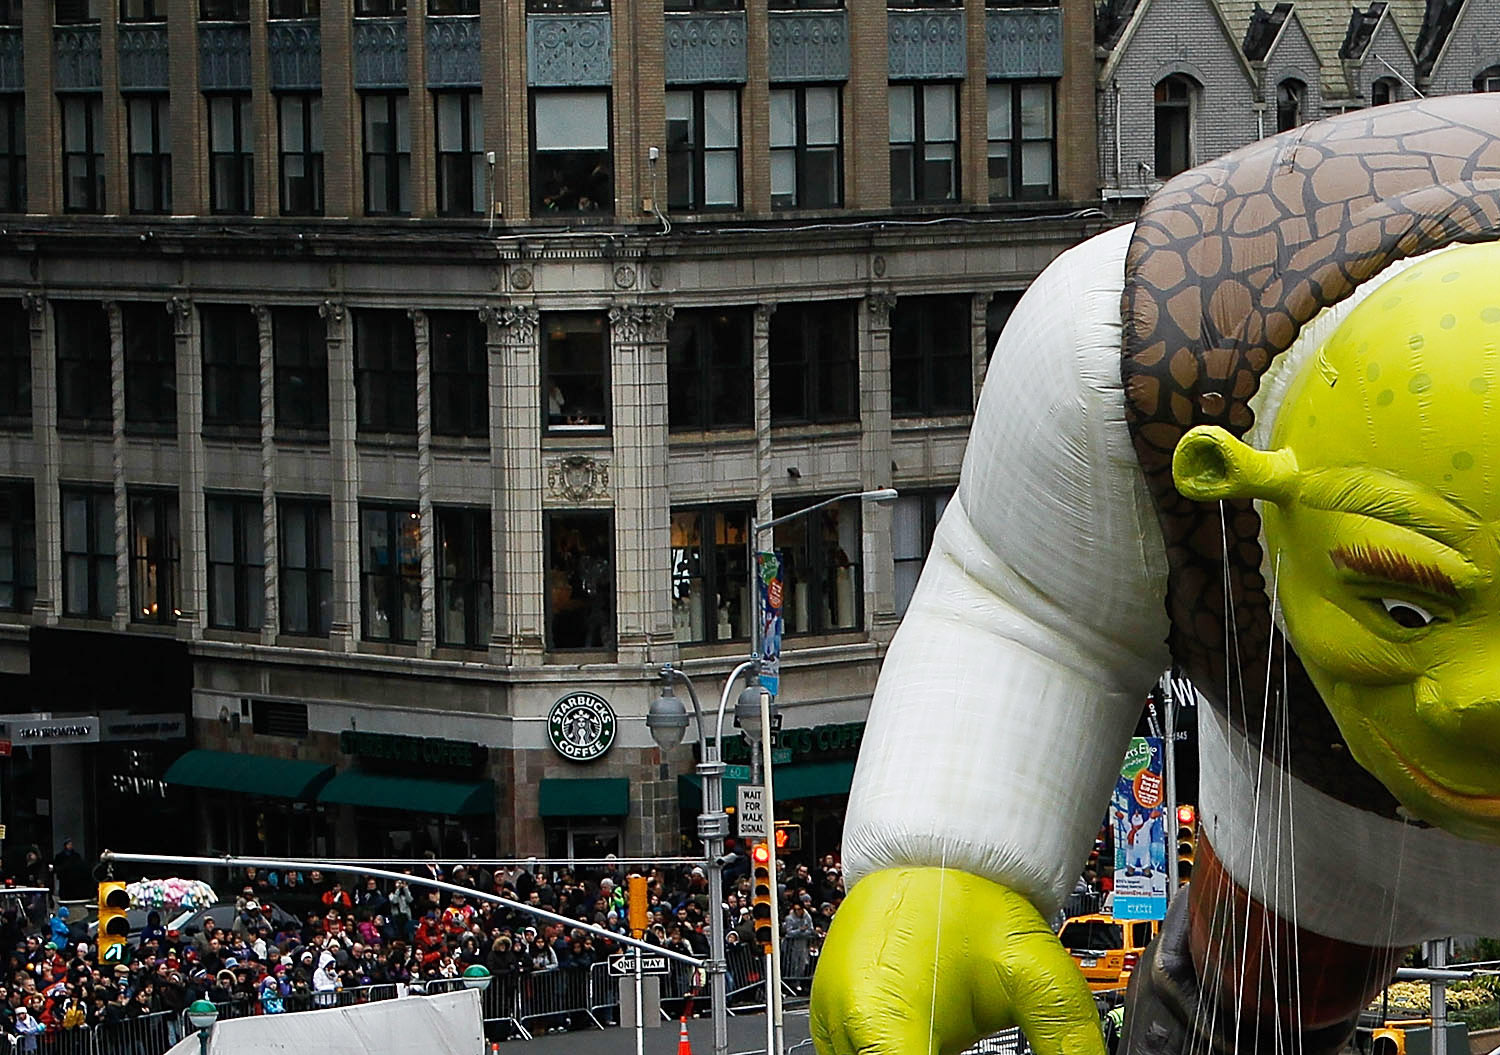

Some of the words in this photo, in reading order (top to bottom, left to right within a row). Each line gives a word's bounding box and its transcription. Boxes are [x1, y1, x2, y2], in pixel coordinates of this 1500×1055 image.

[552, 696, 612, 724] STARBUCKS
[559, 740, 605, 757] COFFEE
[730, 768, 741, 776] 60
[743, 791, 762, 799] WAIT
[745, 802, 760, 811] FOR
[742, 813, 763, 822] WALK
[741, 824, 764, 833] SIGNAL
[618, 959, 636, 970] ONE
[643, 959, 661, 968] WAY
